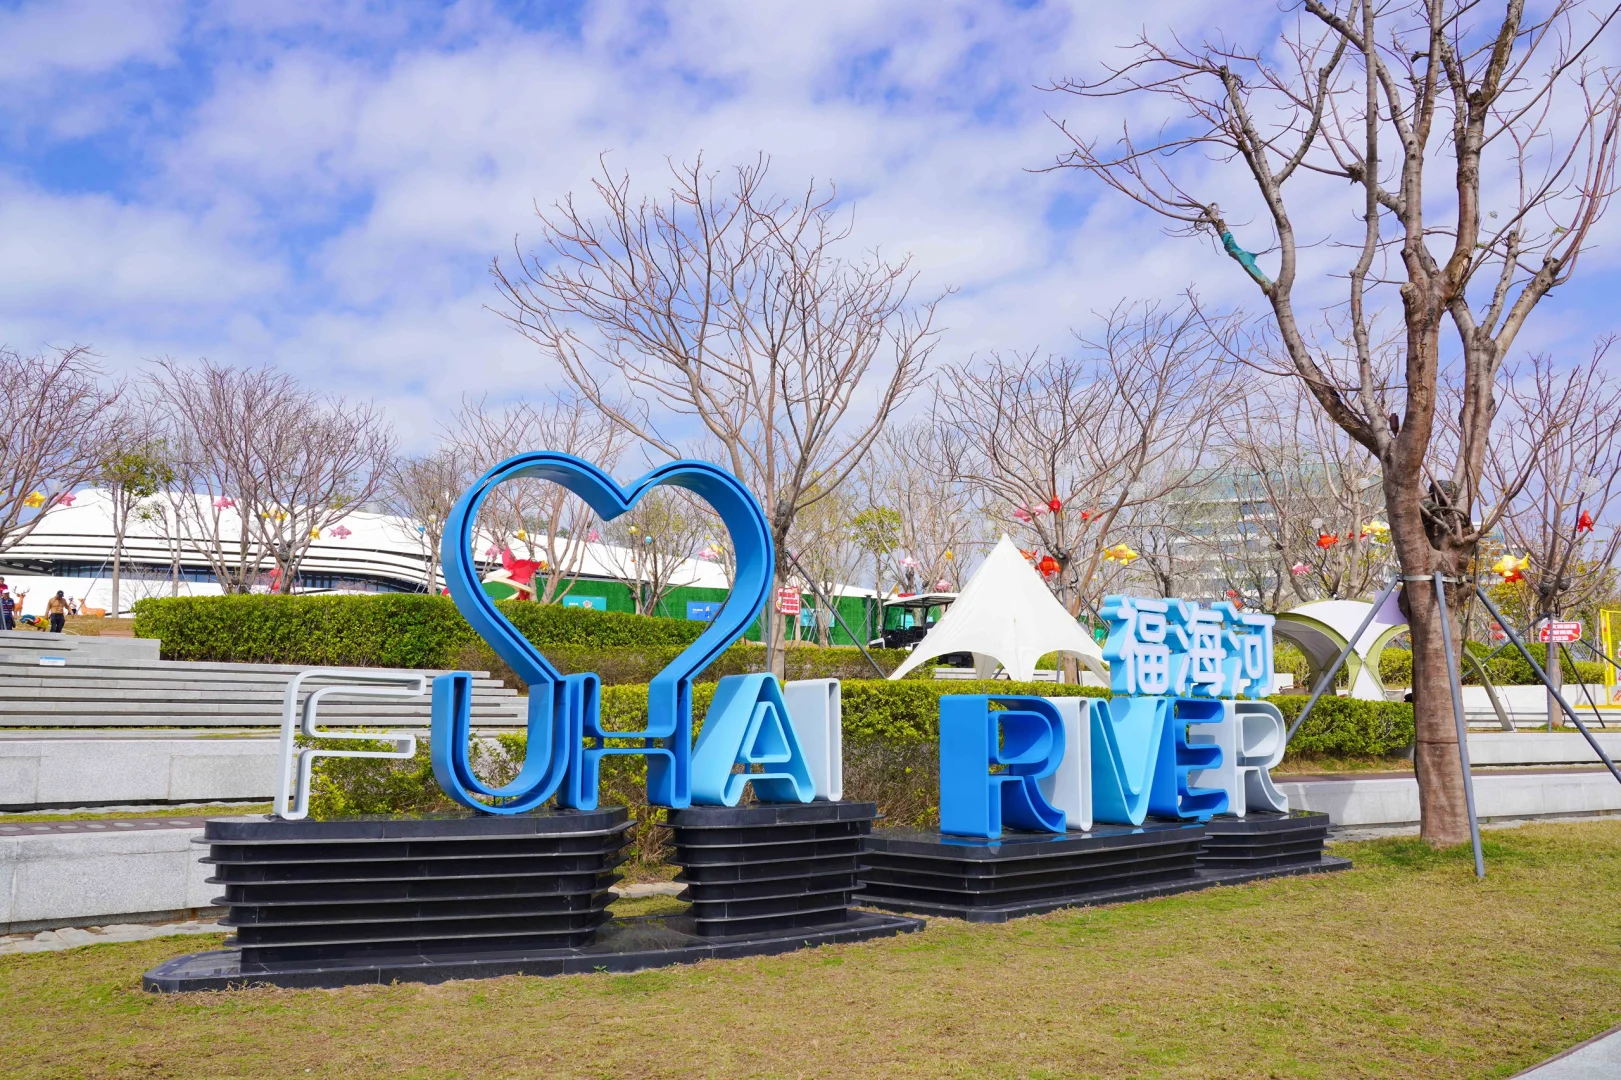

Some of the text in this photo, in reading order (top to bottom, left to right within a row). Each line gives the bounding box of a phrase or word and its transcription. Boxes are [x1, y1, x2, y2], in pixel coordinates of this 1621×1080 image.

[1100, 594, 1276, 697] 福海河
[273, 670, 1289, 838] FUHAI RIVER
